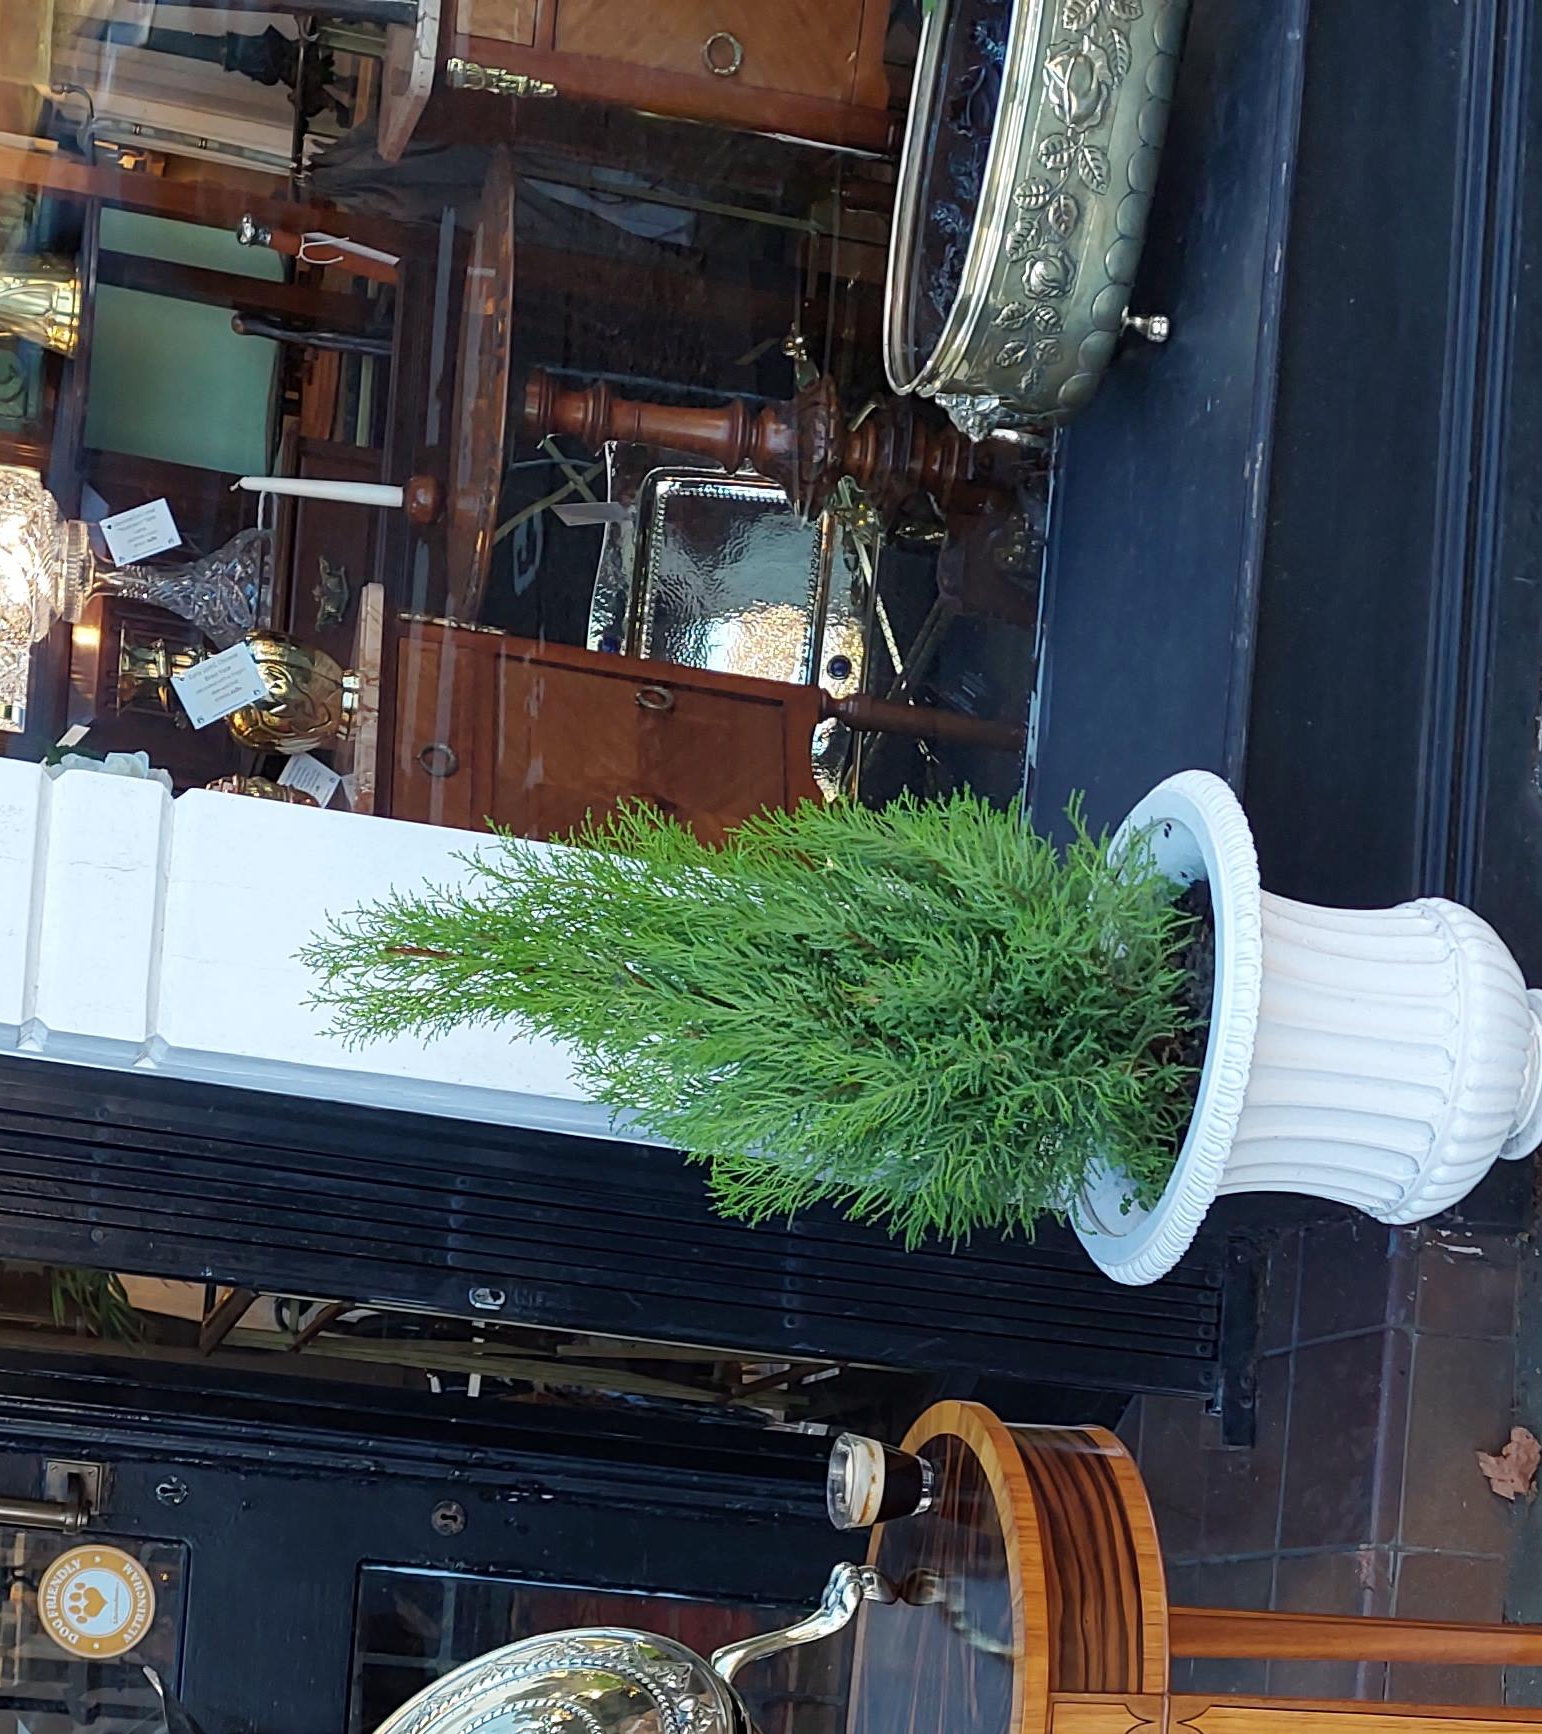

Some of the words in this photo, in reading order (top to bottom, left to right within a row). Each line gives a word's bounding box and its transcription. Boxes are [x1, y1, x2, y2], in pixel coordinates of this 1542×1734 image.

[45, 1558, 82, 1618] FRIENDLY
[122, 1561, 147, 1643] ALTRINCHAM
[52, 1618, 80, 1644] DOG
